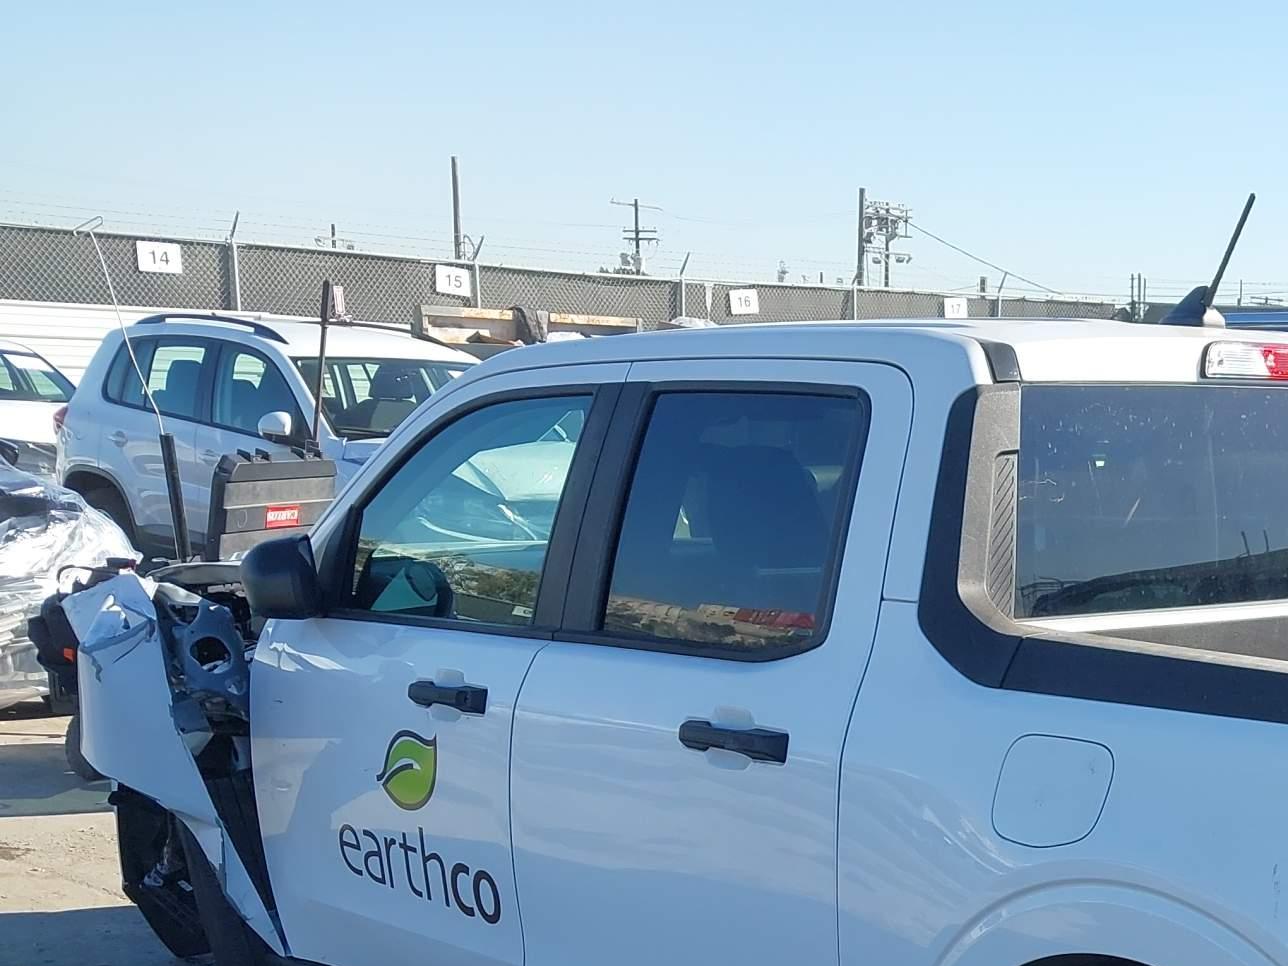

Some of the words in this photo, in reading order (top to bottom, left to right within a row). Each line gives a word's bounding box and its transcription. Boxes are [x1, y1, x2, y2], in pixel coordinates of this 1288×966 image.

[148, 250, 170, 265] 14
[446, 274, 462, 288] 15
[738, 296, 751, 307] 16
[951, 304, 961, 314] 17
[339, 823, 502, 925] earthco
